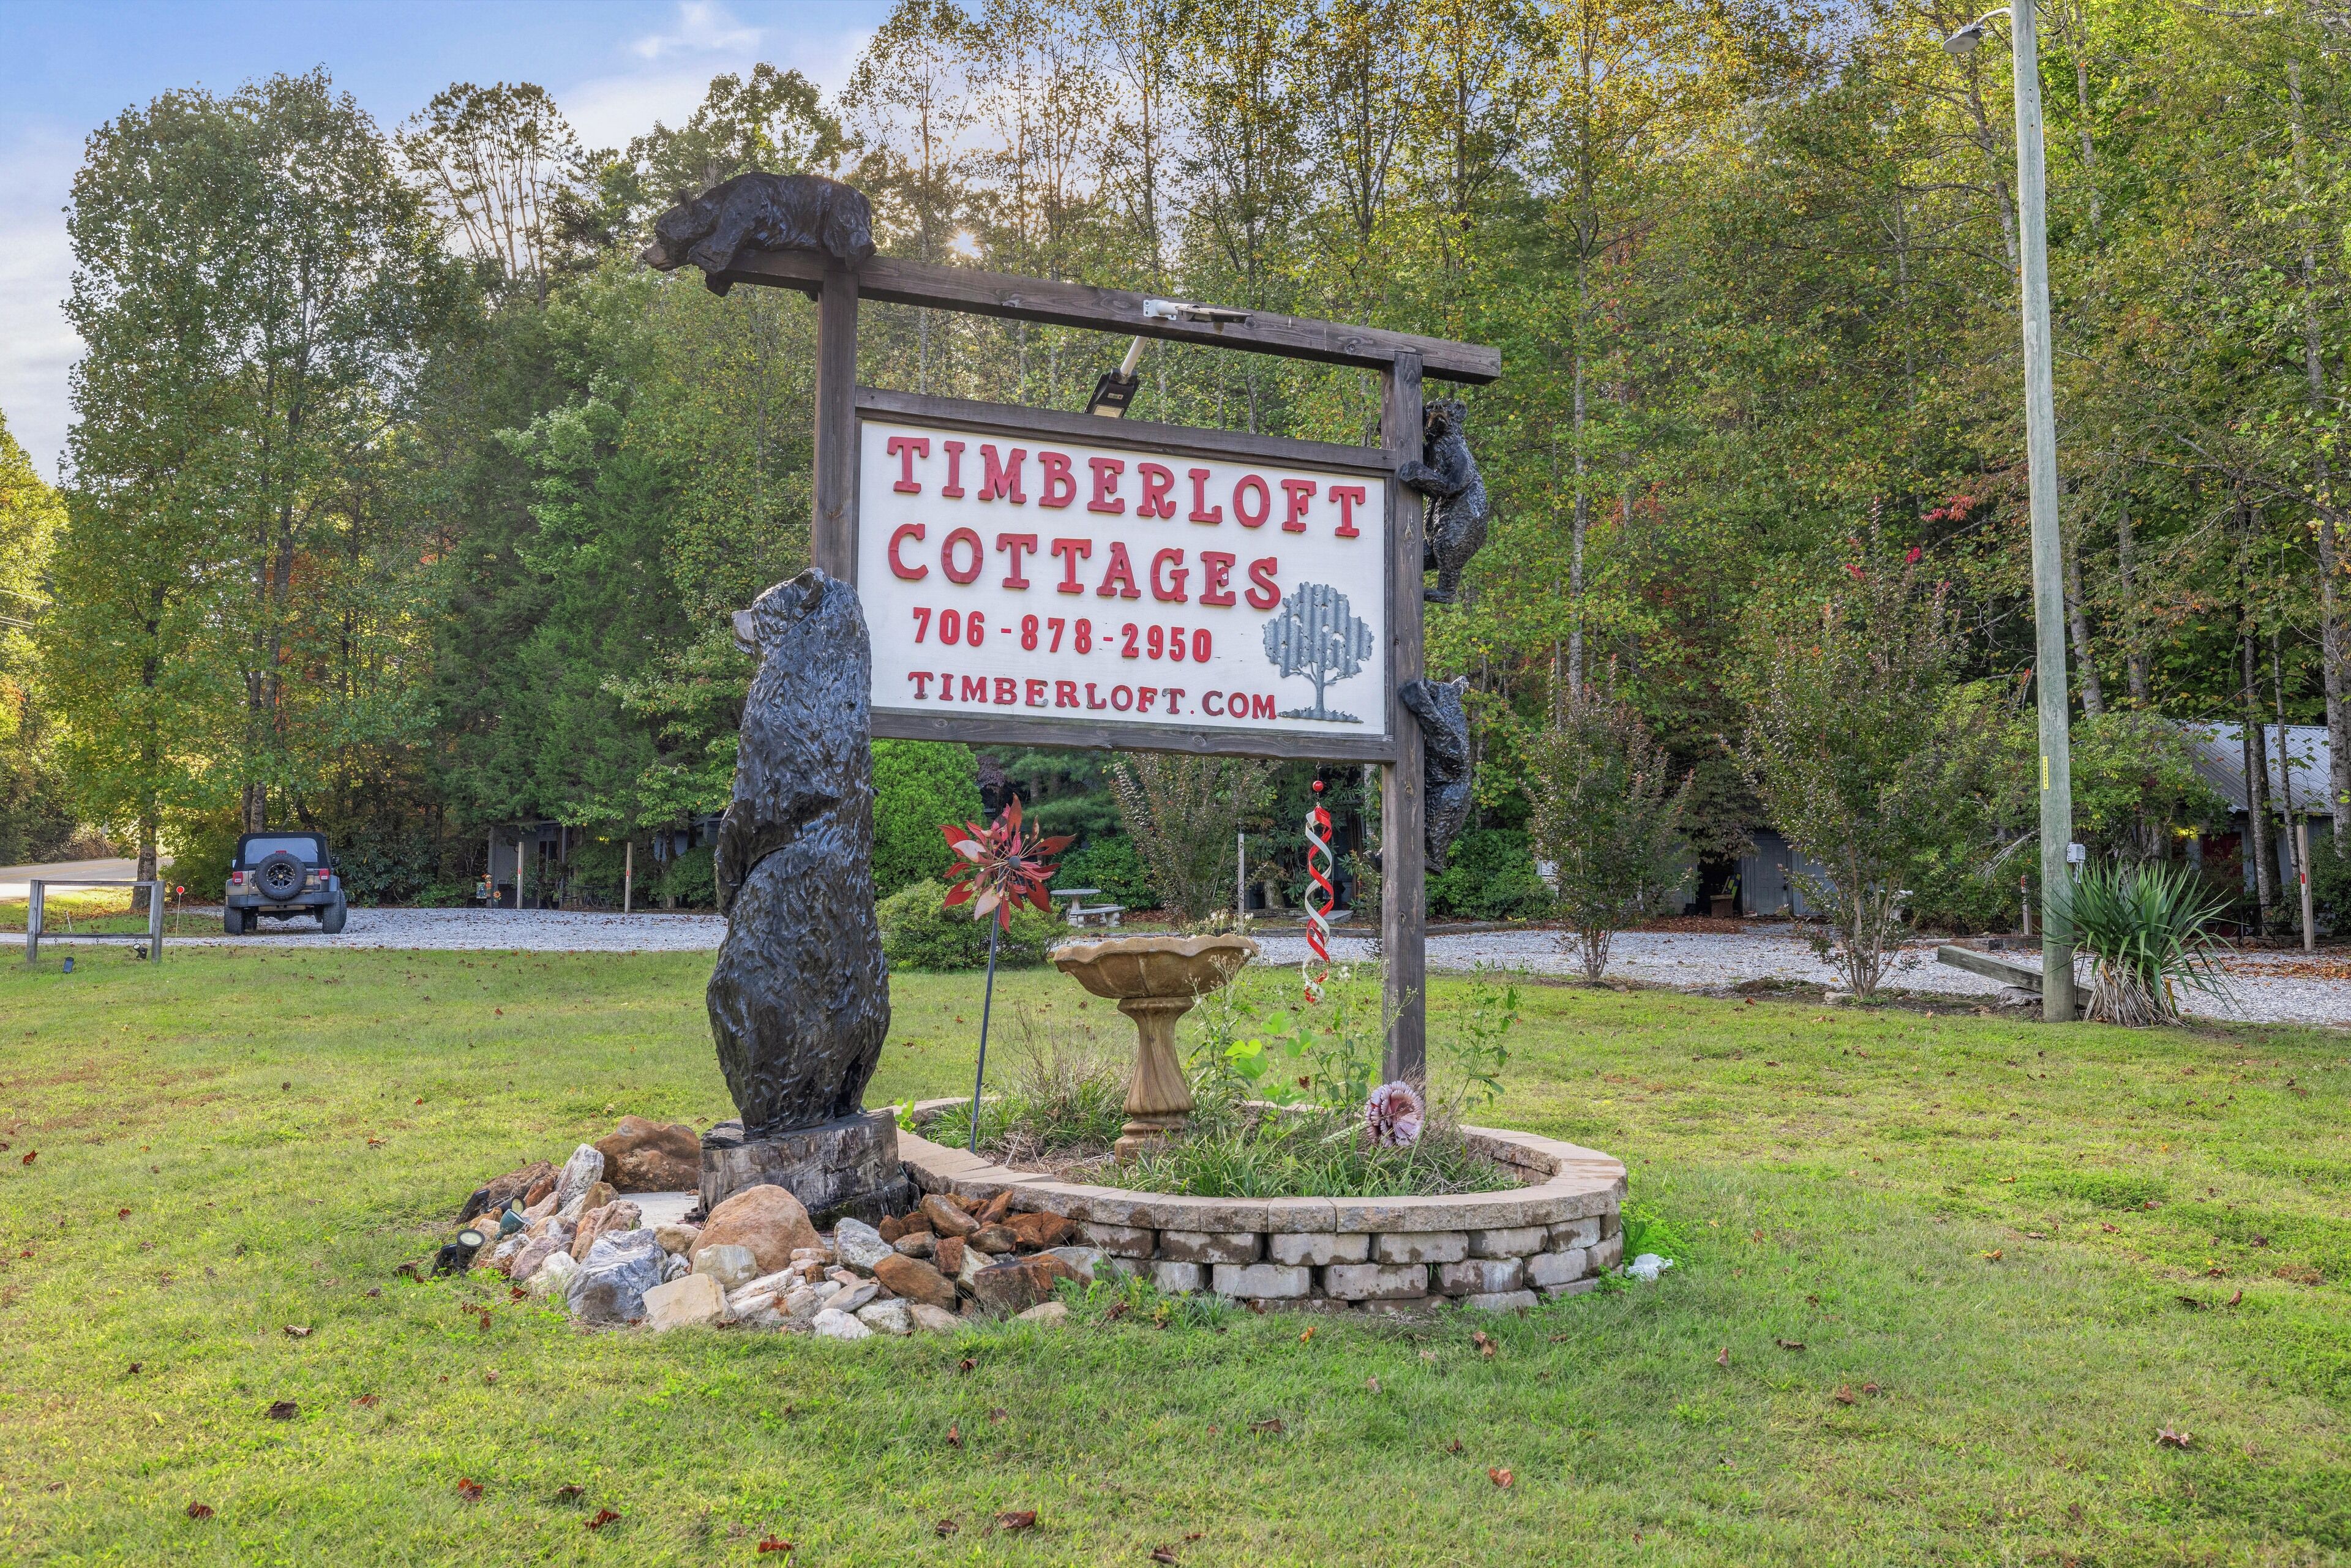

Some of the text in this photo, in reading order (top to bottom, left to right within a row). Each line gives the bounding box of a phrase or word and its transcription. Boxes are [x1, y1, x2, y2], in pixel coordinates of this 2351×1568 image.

[888, 436, 1366, 539] TIMBERLOFT
[888, 523, 1281, 611] COTTAGES
[907, 671, 1277, 720] TIMBERLOFT.COM
